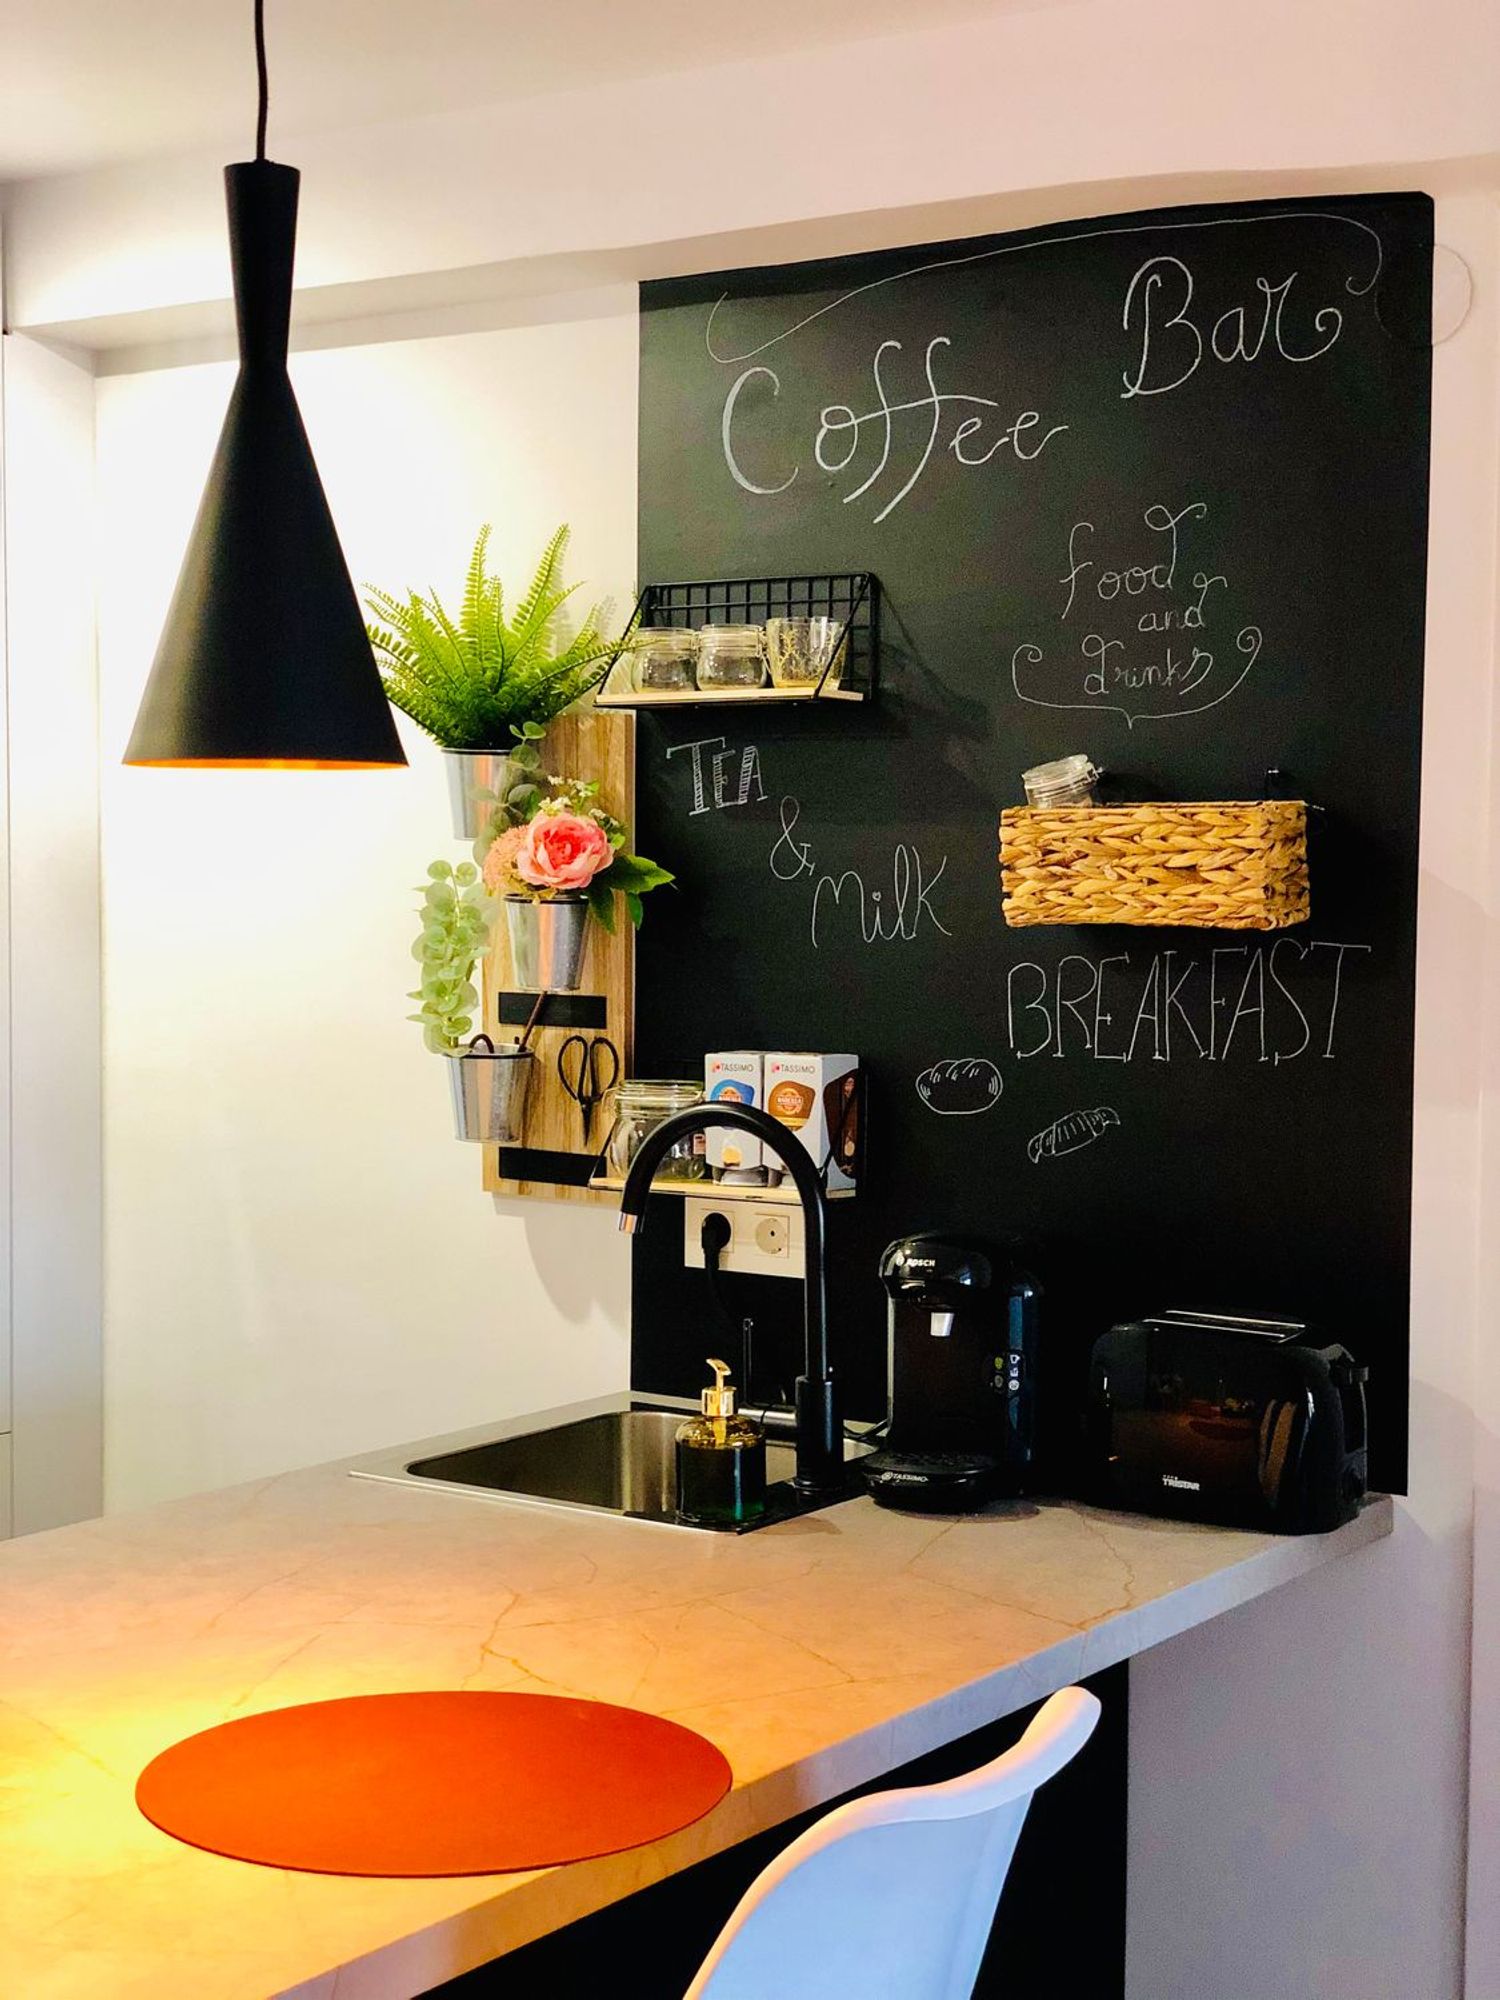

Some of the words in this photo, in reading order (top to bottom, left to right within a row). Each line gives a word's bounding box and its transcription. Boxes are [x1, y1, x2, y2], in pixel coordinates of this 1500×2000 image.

[722, 336, 1069, 524] Coffee
[1120, 254, 1343, 398] Bar
[1059, 502, 1207, 620] food
[1138, 571, 1228, 631] and
[1081, 634, 1214, 695] drinks
[666, 736, 769, 816] TEA
[768, 796, 816, 881] &
[1006, 938, 1372, 1064] BREAKFAST
[721, 1063, 754, 1072] TASSIMO
[780, 1063, 816, 1074] TASSIMO
